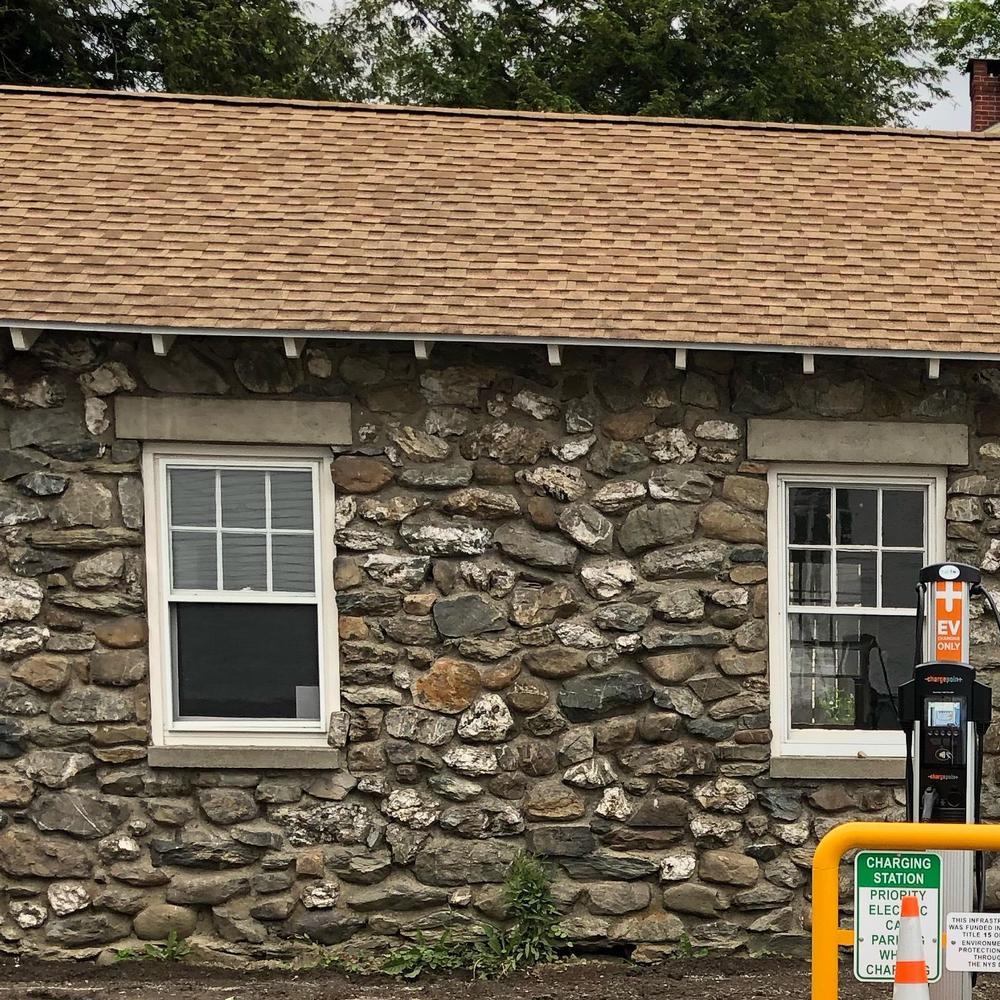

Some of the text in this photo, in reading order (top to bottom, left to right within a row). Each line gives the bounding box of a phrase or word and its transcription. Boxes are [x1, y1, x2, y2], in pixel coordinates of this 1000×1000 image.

[937, 620, 961, 635] EV
[937, 642, 961, 650] ONLY
[866, 856, 932, 869] CHARGING
[873, 872, 924, 884] STATION
[869, 905, 928, 916] ELECC
